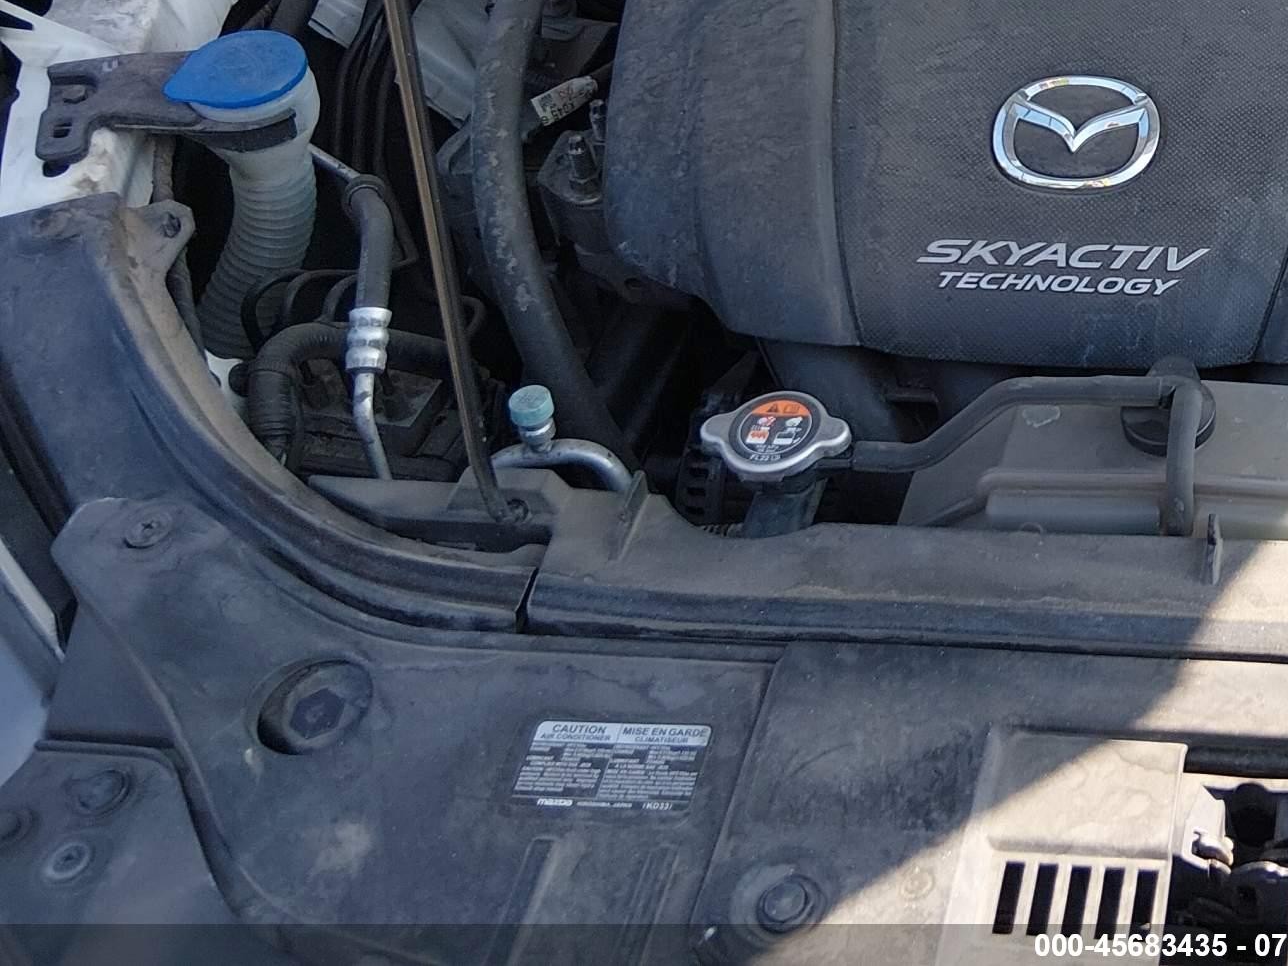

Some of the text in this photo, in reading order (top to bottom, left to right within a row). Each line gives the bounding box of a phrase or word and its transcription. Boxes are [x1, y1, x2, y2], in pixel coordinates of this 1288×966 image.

[916, 239, 1211, 272] SKYACTIV
[938, 271, 1182, 296] TECHNOLOGY
[553, 724, 607, 734] CAUTION
[622, 726, 708, 737] MISE EN GARDE
